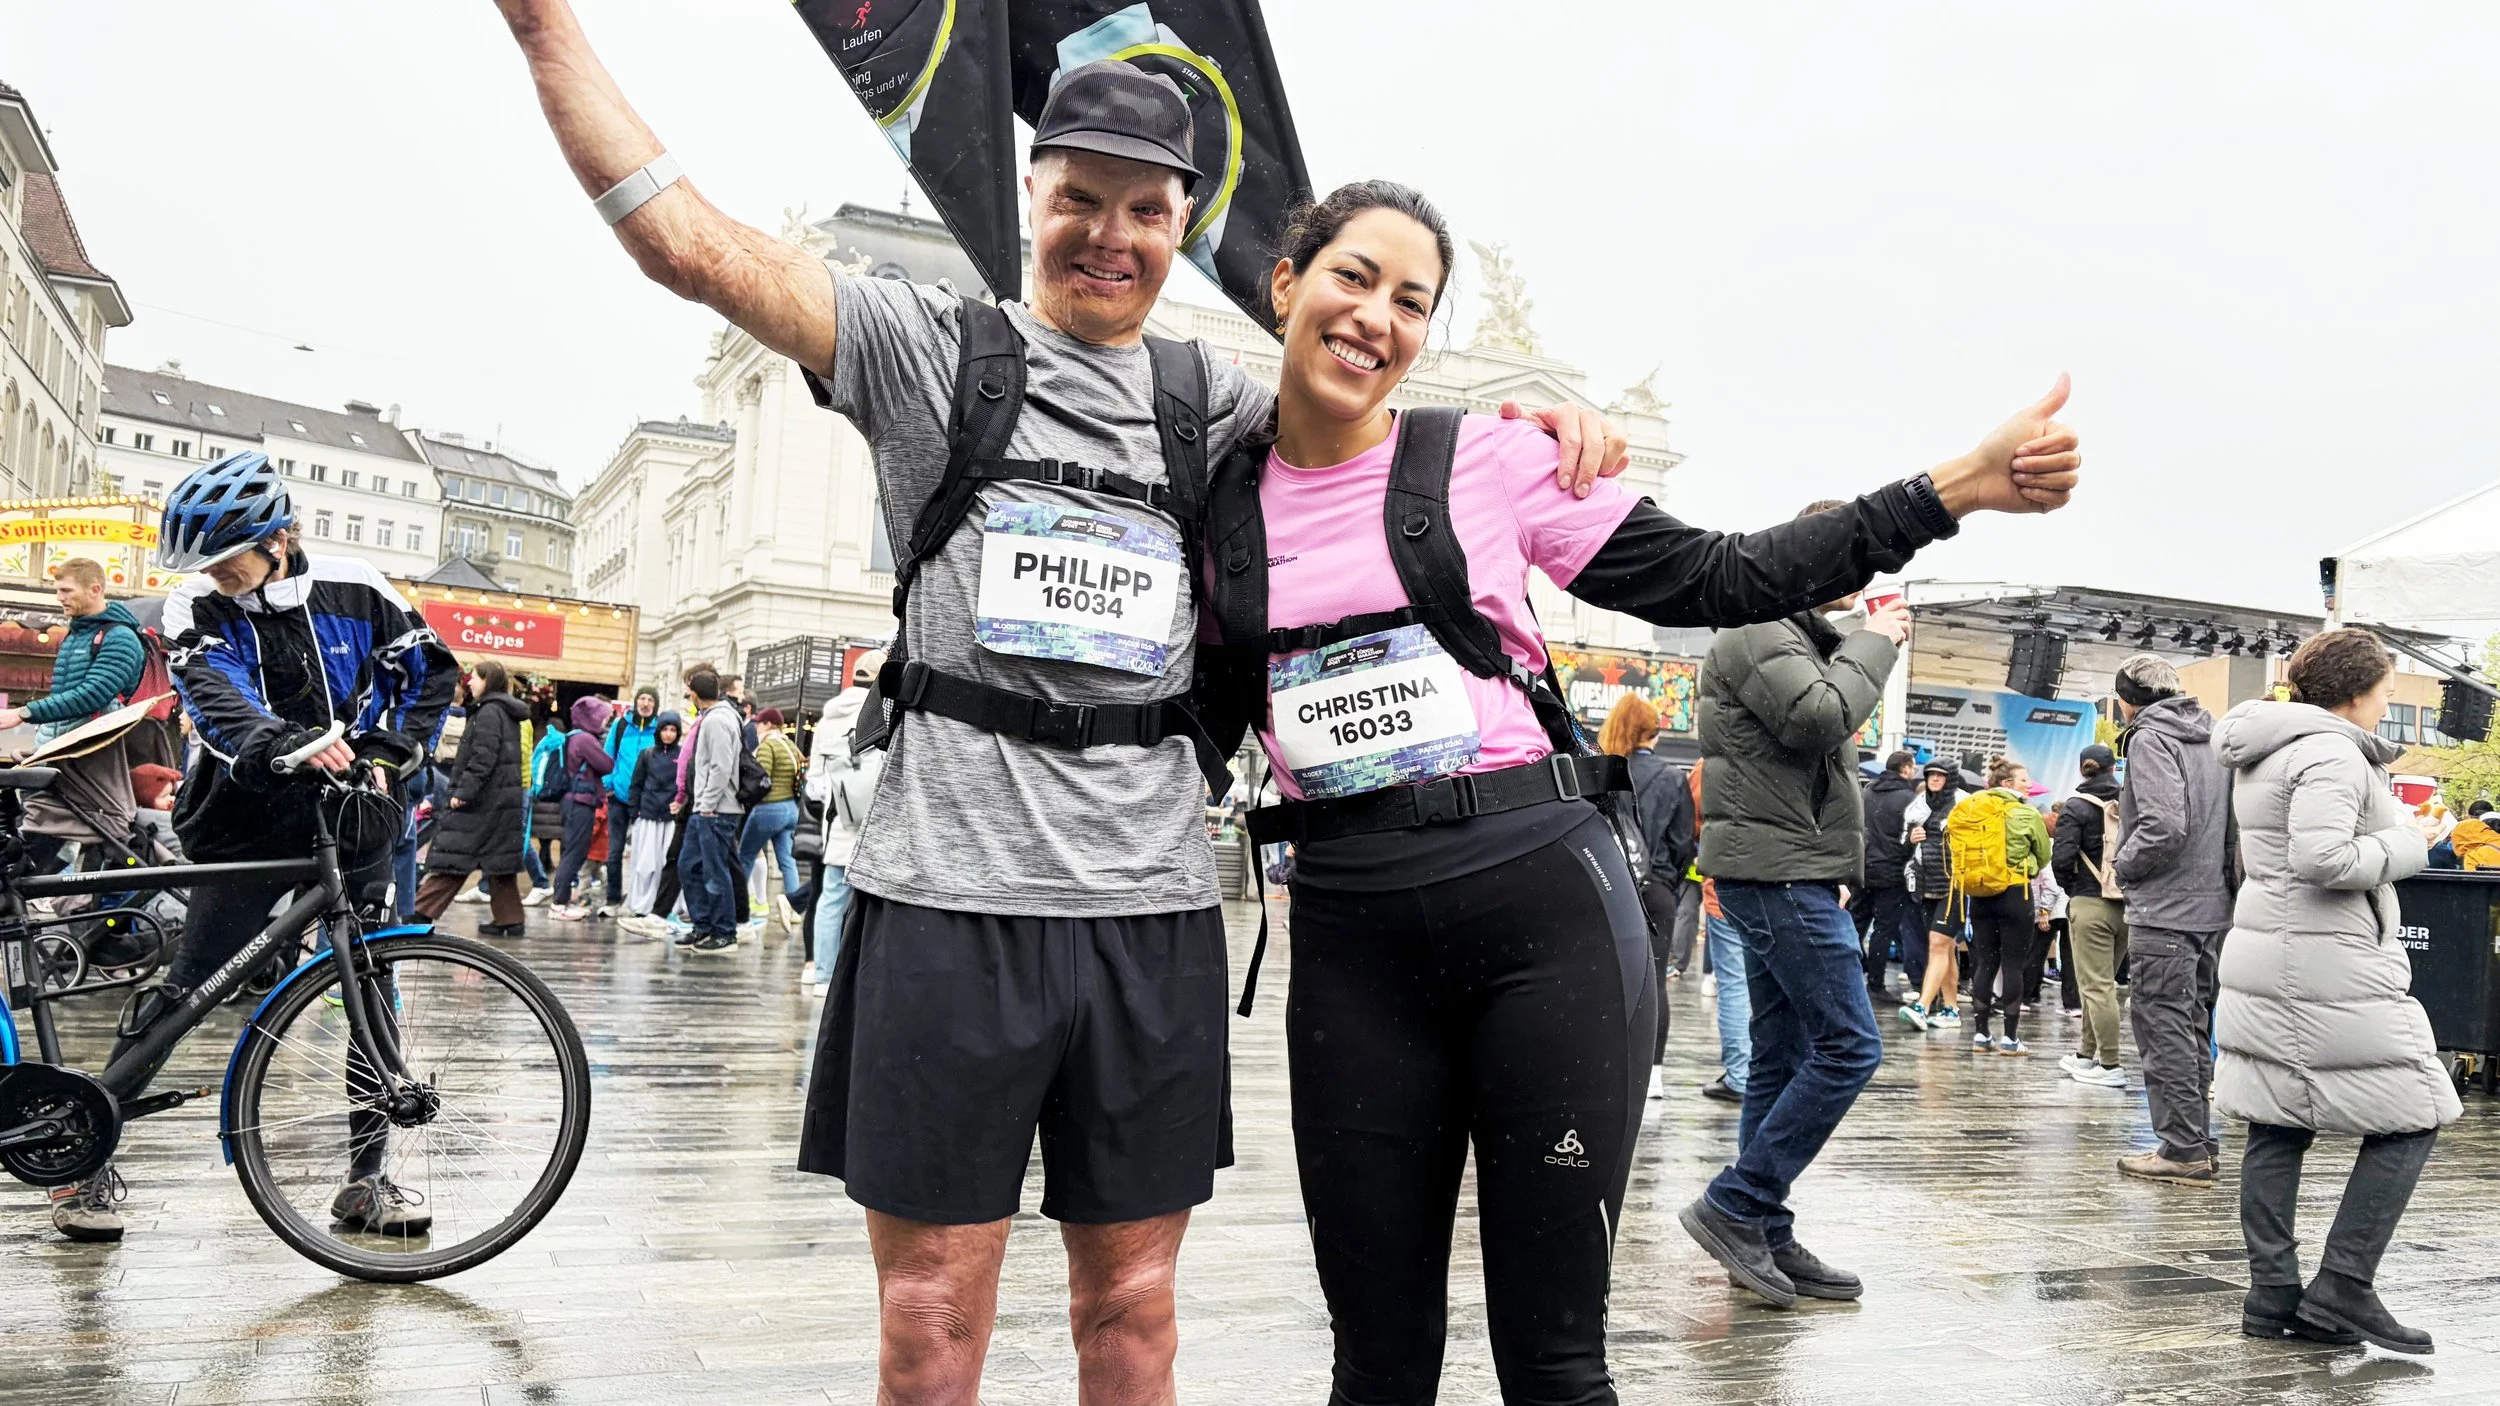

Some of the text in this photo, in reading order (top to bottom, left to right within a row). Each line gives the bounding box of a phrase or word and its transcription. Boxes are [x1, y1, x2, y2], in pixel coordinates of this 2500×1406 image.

[842, 29, 882, 51] Laufen
[876, 76, 895, 95] und
[1181, 67, 1201, 82] START
[1013, 551, 1153, 598] PHILIPP
[1042, 585, 1124, 619] 16034
[461, 628, 525, 649] Crêpes
[1298, 676, 1439, 724] CHRISTINA
[1569, 680, 1650, 712] QUESADIAS
[1329, 709, 1413, 747] 16033
[1418, 744, 1444, 755] PACER
[1385, 774, 1409, 784] SPORT
[1582, 847, 1613, 892] CERAMIWARM
[2402, 940, 2430, 950] VICE
[200, 931, 273, 997] TOUR DE SUISSE
[1544, 1155, 1590, 1168] odlo
